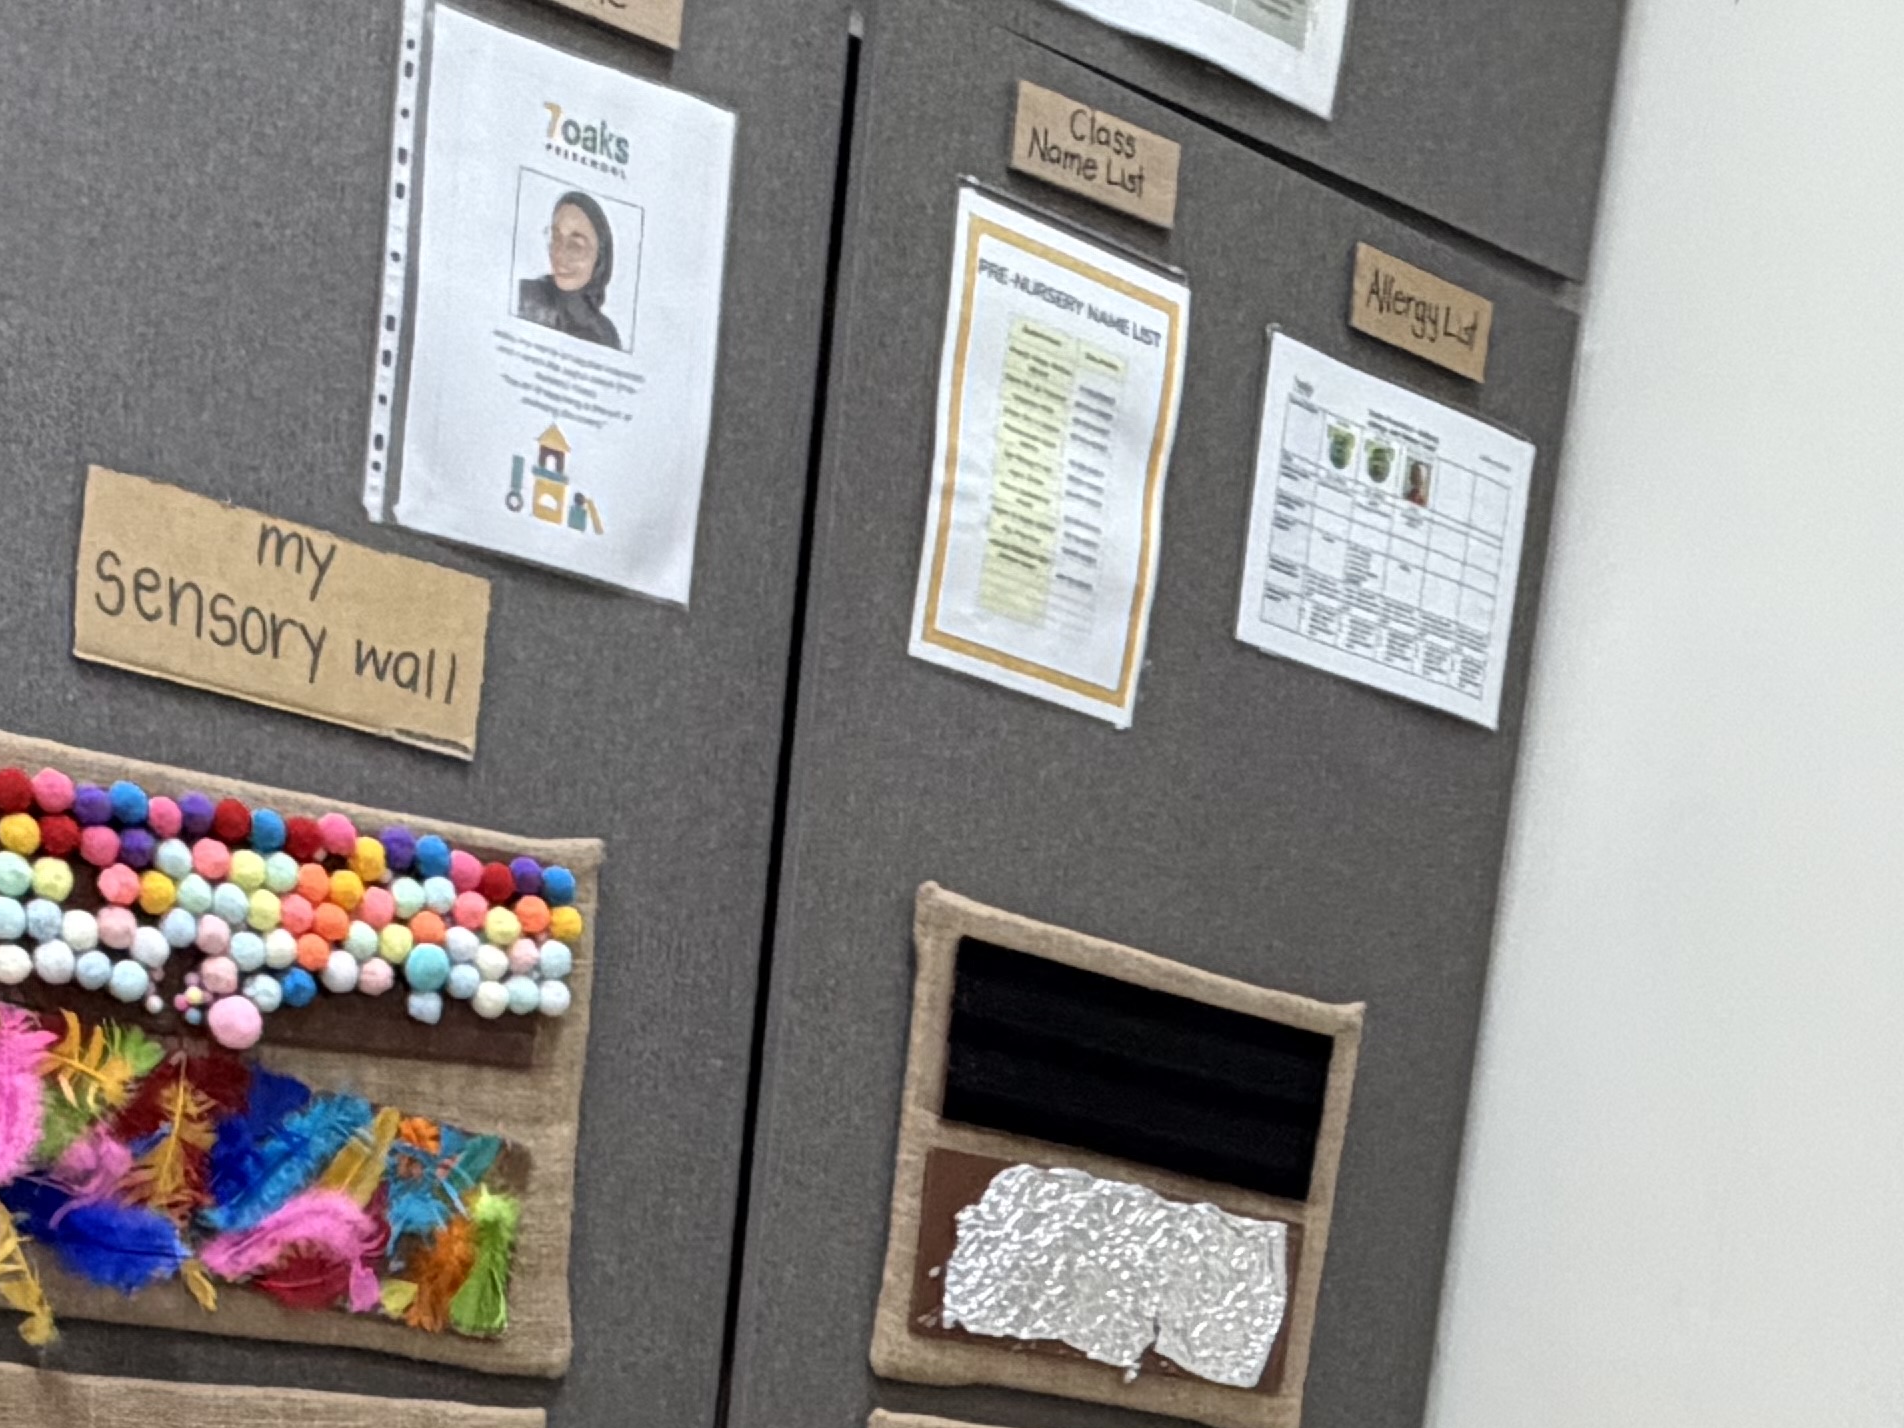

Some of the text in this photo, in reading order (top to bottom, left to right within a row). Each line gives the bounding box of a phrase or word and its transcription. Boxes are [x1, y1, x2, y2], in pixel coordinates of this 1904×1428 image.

[544, 101, 629, 165] 7oaks
[1028, 126, 1145, 199] Name List
[1070, 108, 1137, 159] Class
[978, 257, 1085, 315] PRE-NURSERY
[1087, 303, 1130, 336] NAME
[1132, 322, 1162, 348] LIST
[1366, 269, 1439, 343] Allergy
[258, 522, 337, 601] my
[355, 639, 458, 704] wall
